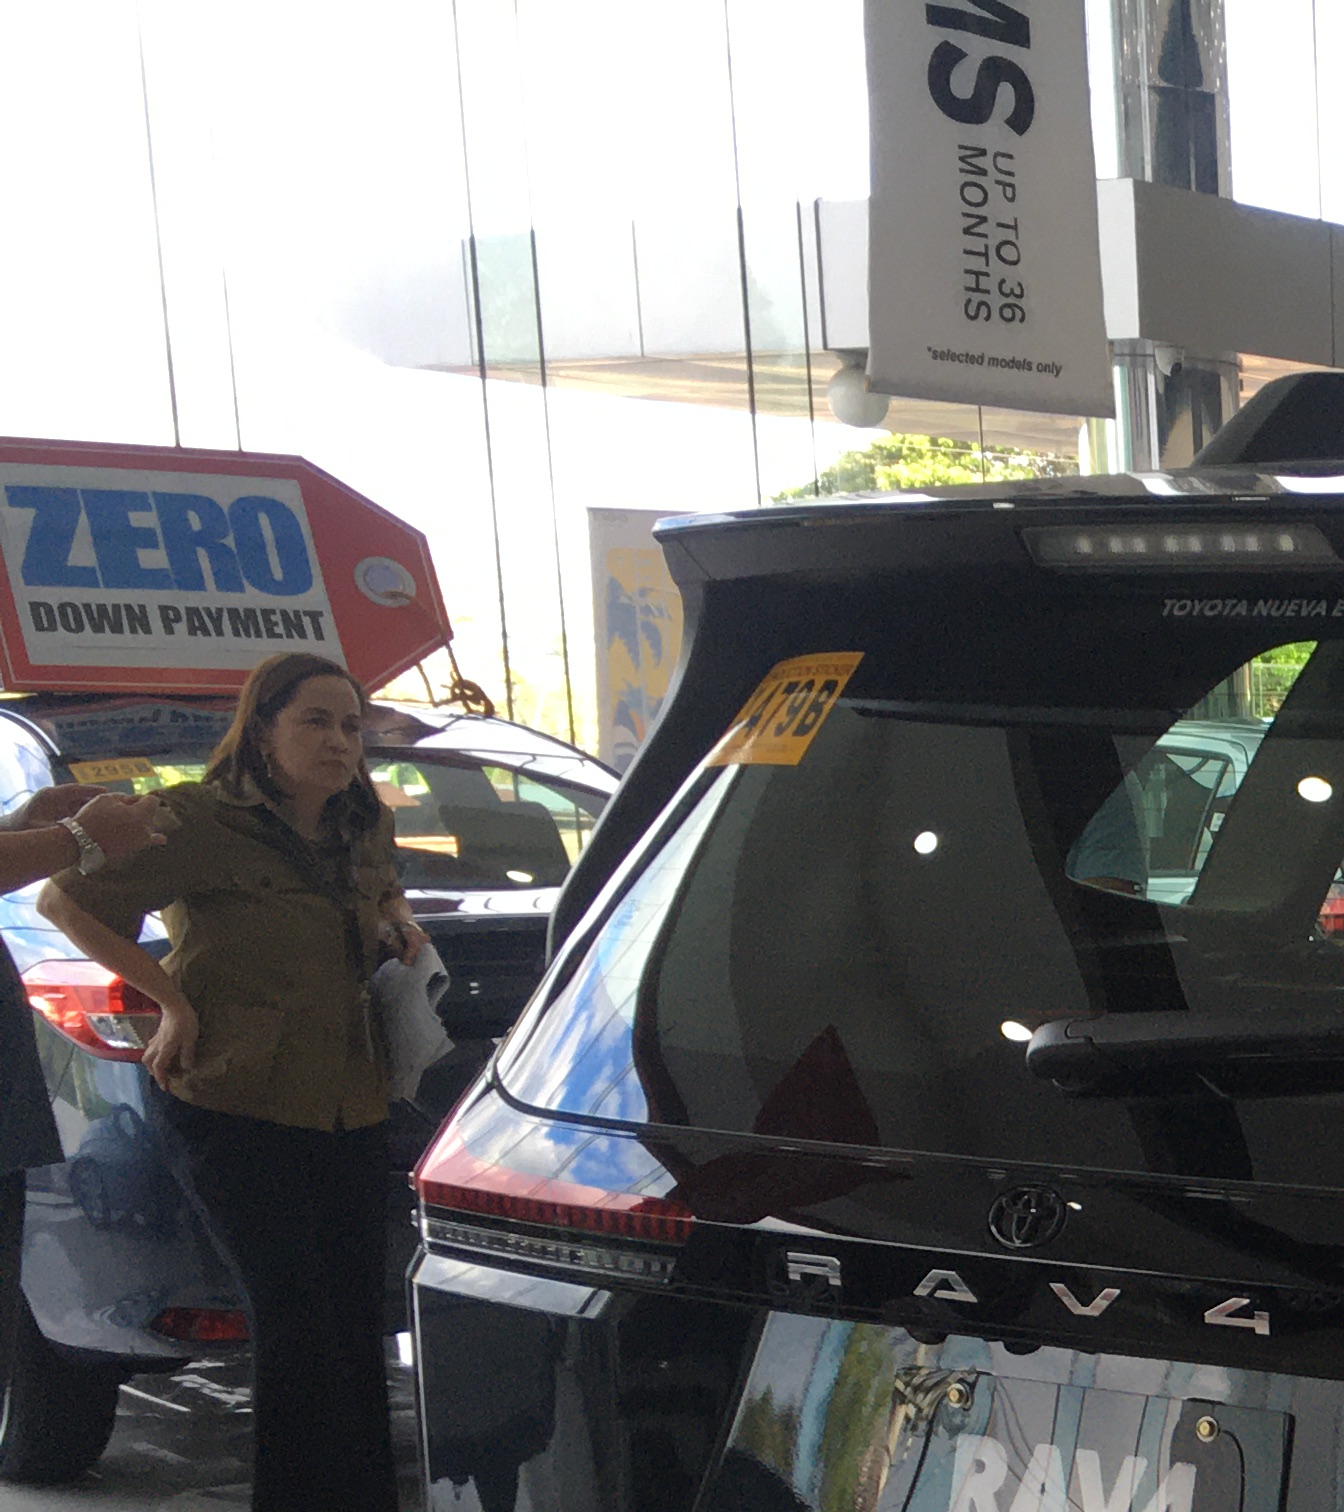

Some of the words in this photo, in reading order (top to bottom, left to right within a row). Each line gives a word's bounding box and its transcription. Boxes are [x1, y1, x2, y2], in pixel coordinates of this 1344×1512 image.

[992, 150, 1016, 203] UP
[957, 143, 992, 322] MONTHS
[995, 216, 1021, 266] TO
[997, 277, 1026, 323] 36
[987, 355, 1033, 372] models
[1036, 361, 1063, 378] only
[4, 485, 314, 597] ZERO
[28, 600, 153, 635] DOWN
[157, 603, 326, 642] PAYMENT
[1161, 598, 1248, 617] TOYOTA
[1252, 598, 1328, 617] NUEVA
[783, 1250, 1273, 1336] RAV4
